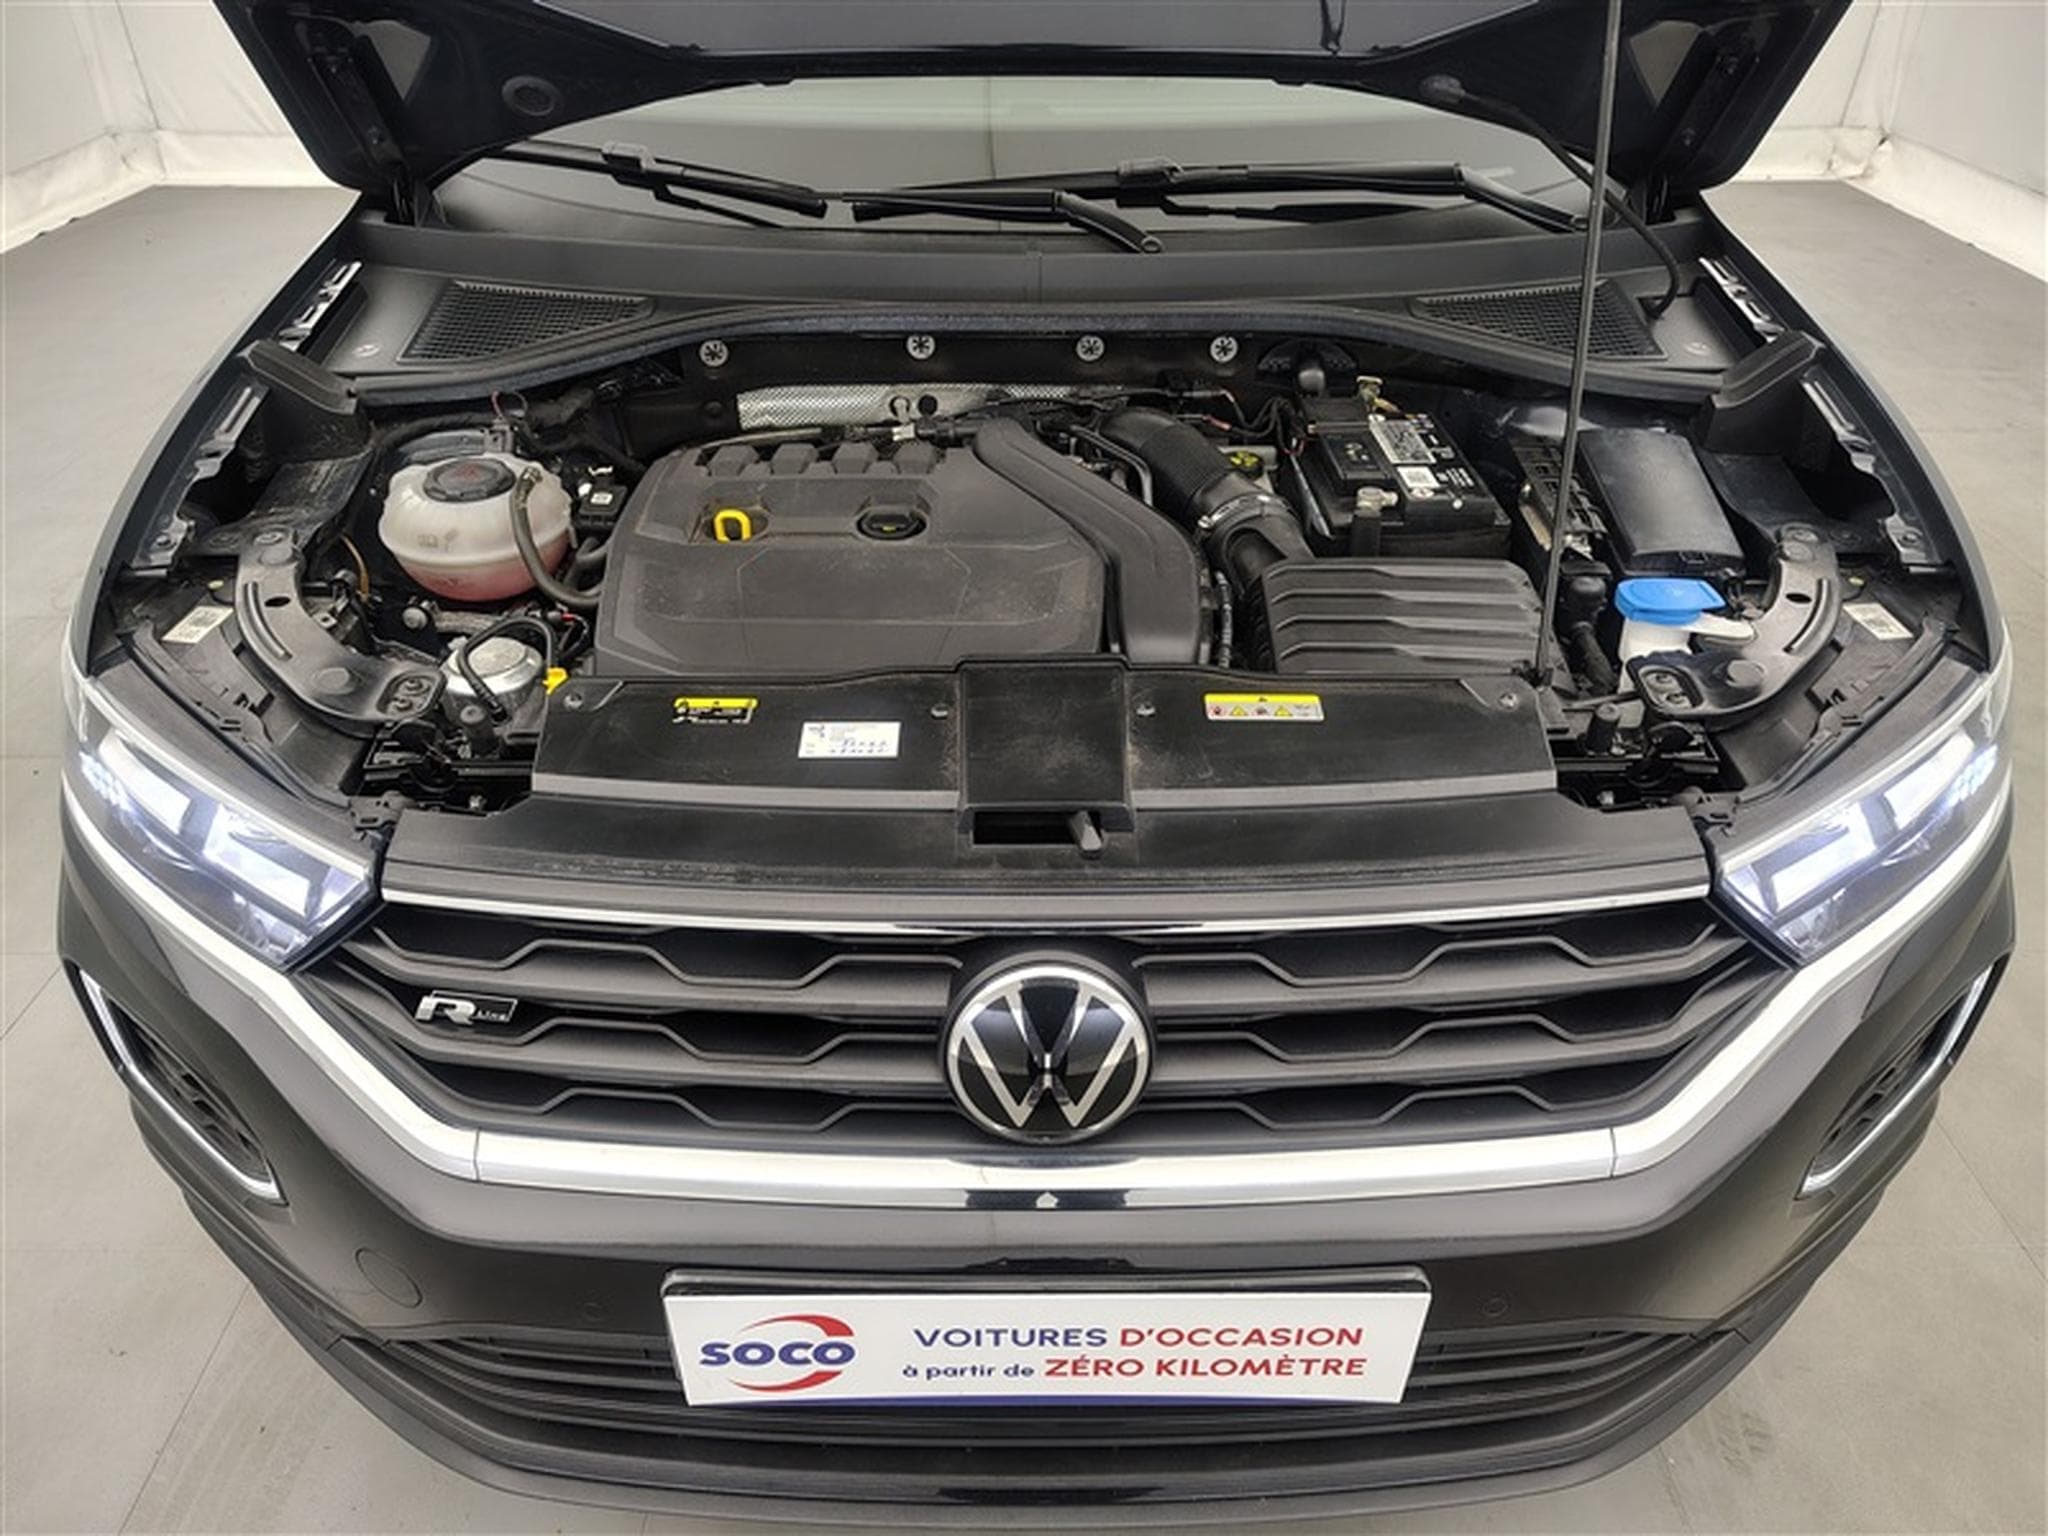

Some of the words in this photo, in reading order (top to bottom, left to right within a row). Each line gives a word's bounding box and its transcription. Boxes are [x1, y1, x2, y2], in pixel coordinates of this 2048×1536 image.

[914, 1328, 1107, 1347] VOITURES
[1119, 1327, 1363, 1347] D'OCCASION
[700, 1341, 856, 1367] SOCO
[903, 1363, 919, 1378] à
[925, 1362, 997, 1382] partir
[1004, 1361, 1035, 1378] de
[1044, 1355, 1145, 1377] ZÉRO
[1155, 1354, 1367, 1377] KILOMÈTRE
